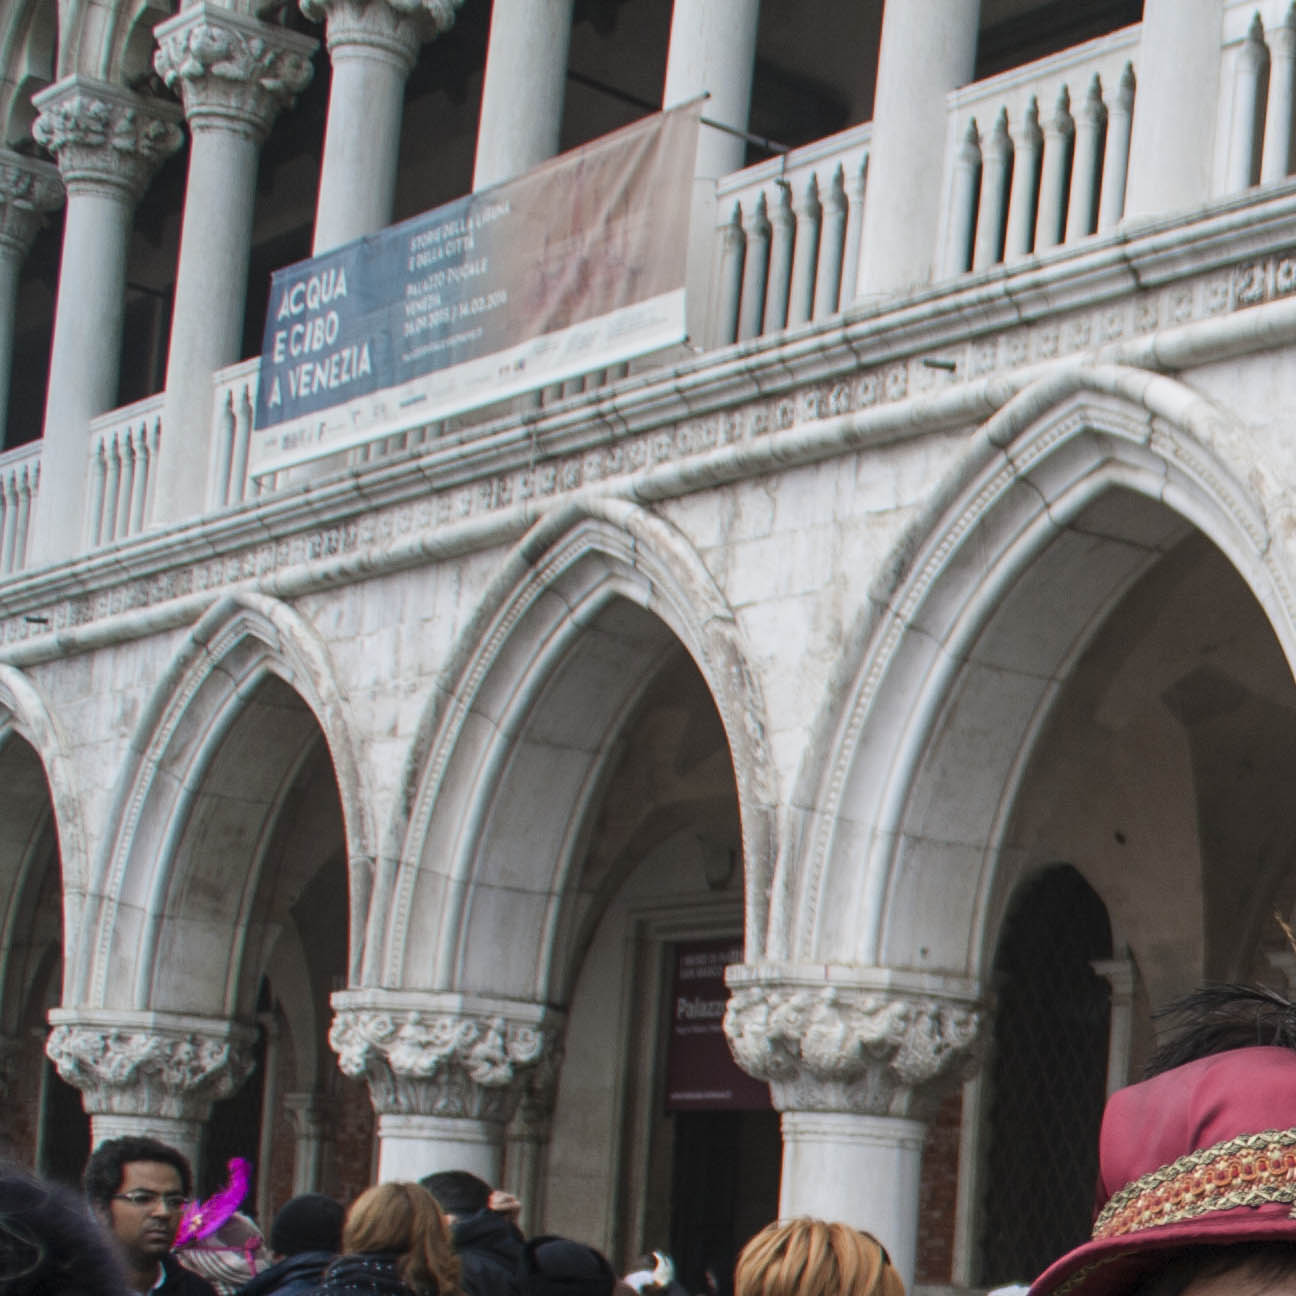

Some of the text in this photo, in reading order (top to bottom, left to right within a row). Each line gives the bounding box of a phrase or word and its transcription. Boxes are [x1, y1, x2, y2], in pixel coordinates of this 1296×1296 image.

[442, 215, 473, 239] DELLA
[406, 256, 488, 296] PALAZZO DUCALE
[408, 255, 415, 273] E
[416, 246, 443, 269] DELLA
[278, 266, 347, 322] ACQUA
[405, 292, 441, 317] VENEZIA
[273, 310, 339, 364] E CIBO
[268, 374, 281, 408] A
[289, 341, 371, 400] VENEZIA
[678, 996, 725, 1020] Palazz
